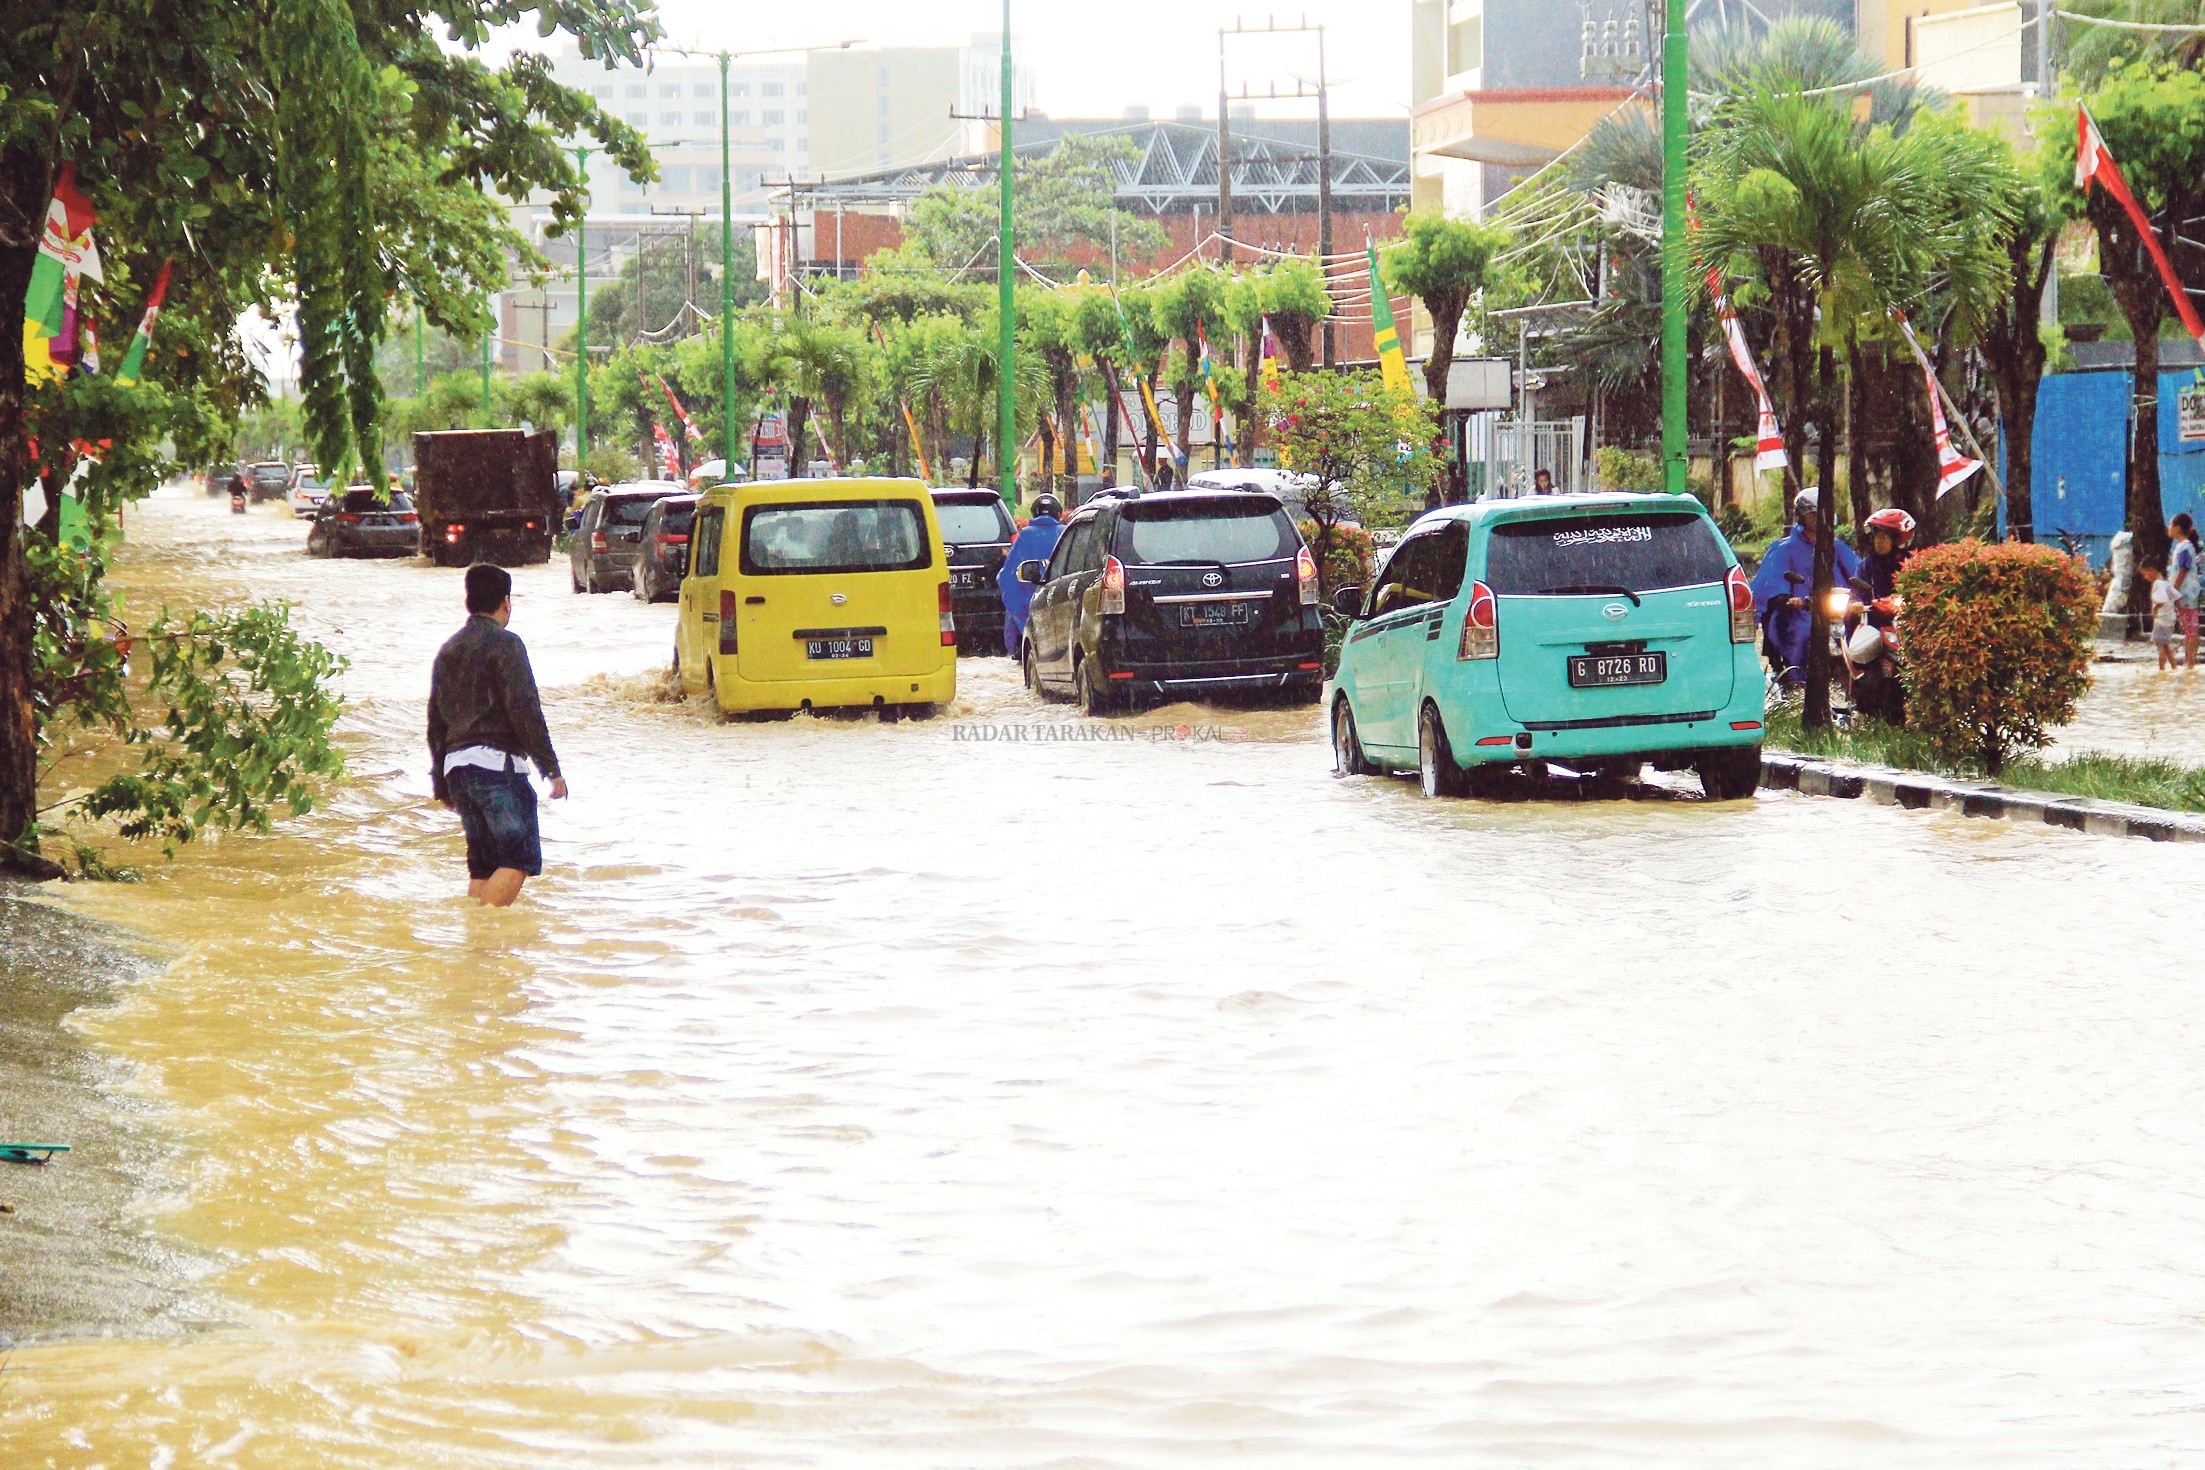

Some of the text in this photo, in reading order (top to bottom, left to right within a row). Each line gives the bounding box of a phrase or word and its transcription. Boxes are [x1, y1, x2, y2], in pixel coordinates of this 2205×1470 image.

[962, 573, 972, 583] FZ
[1183, 607, 1195, 621] KT
[1204, 605, 1226, 618] 1548
[1231, 604, 1245, 617] FF
[808, 641, 822, 654] KU
[828, 640, 852, 653] 1004
[1577, 657, 1656, 677] G 8726 RD
